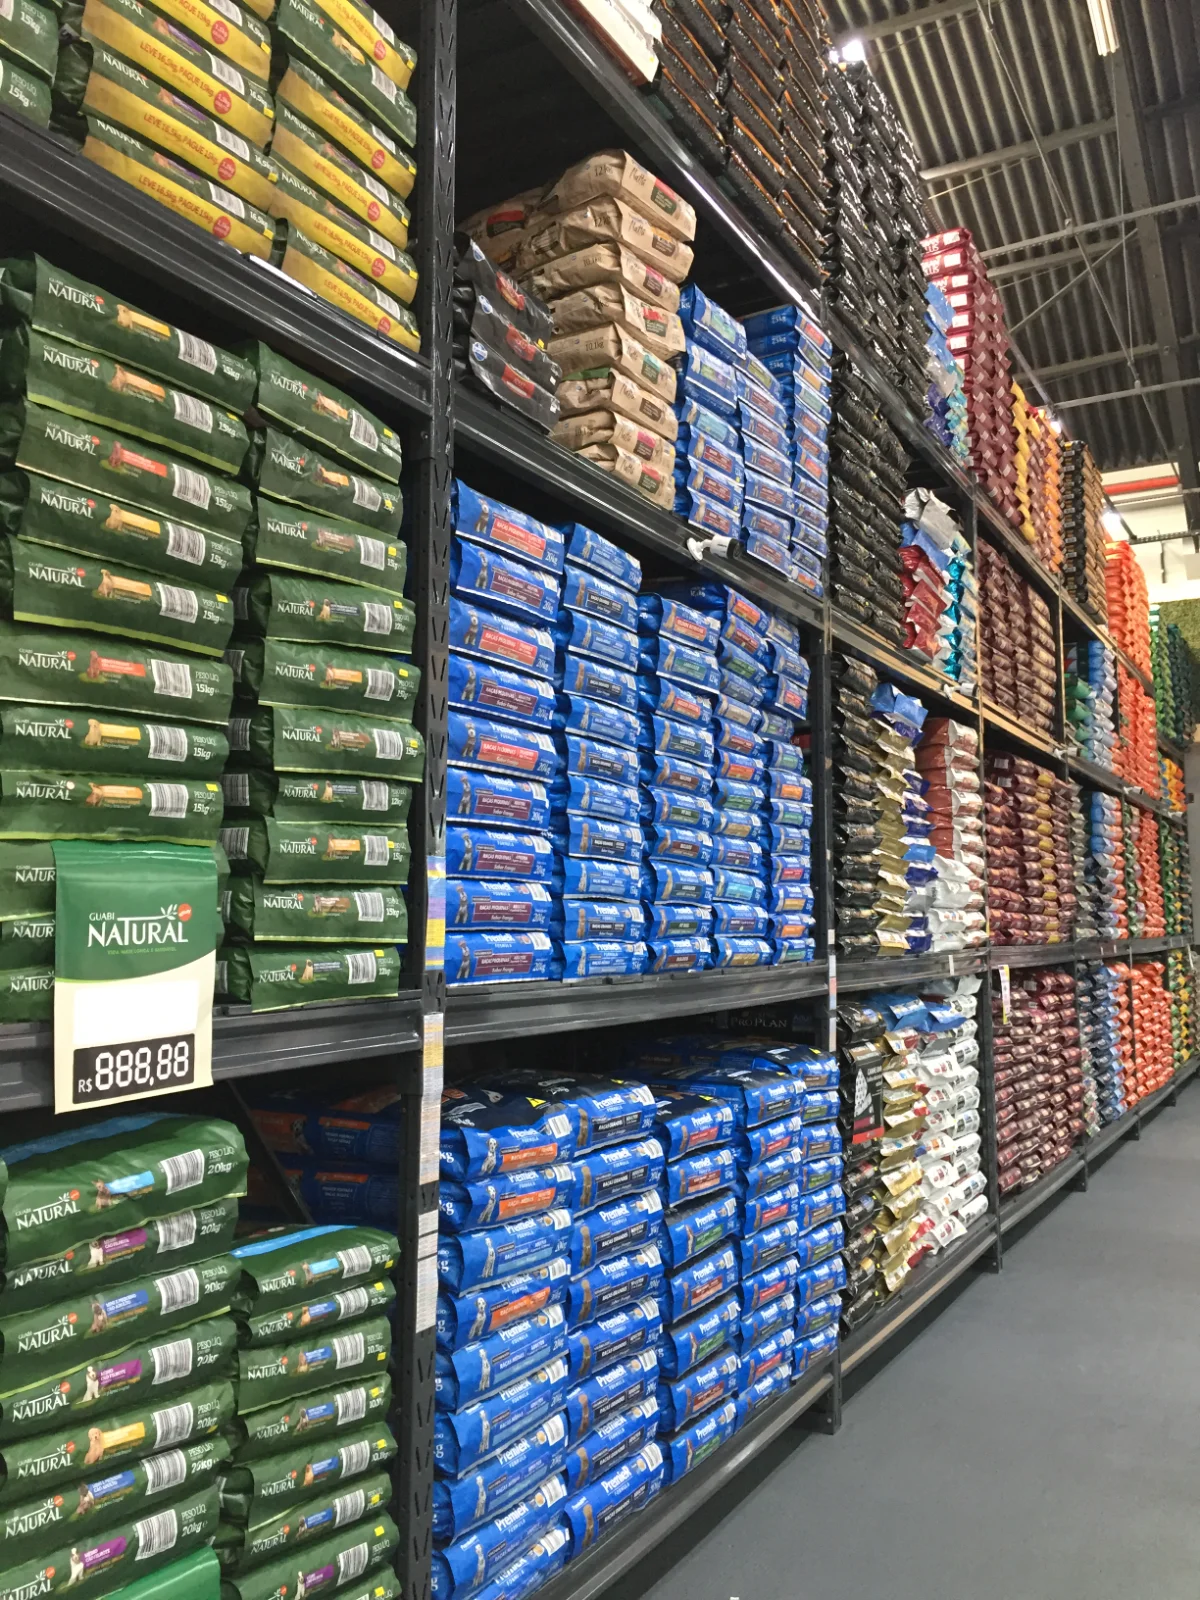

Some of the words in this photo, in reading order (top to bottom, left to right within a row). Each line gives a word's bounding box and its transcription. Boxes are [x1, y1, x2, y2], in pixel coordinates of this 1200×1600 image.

[20, 11, 41, 35] 15kg
[102, 51, 150, 89] NATURAL
[140, 41, 159, 58] LEVE
[179, 63, 202, 87] PAGUE
[9, 84, 30, 107] 15kg
[96, 119, 145, 151] NATURAL
[138, 174, 157, 191] LEVE
[178, 196, 202, 217] PAGUE
[48, 281, 105, 315] NATURAL
[43, 349, 99, 379] NATURAL
[270, 374, 306, 400] NATURAL
[44, 427, 97, 456] NATURAL
[40, 491, 94, 519] NATURAL
[215, 497, 233, 513] 15kg
[267, 521, 307, 540] NATURAL
[209, 553, 228, 569] 15kg
[28, 567, 85, 588] NATURAL
[202, 610, 220, 624] 15kg
[277, 602, 315, 617] NATURAL
[18, 652, 75, 673] NATURAL
[275, 664, 315, 681] NATURAL
[195, 683, 215, 697] 15kg
[15, 722, 72, 740] NATURAL
[282, 729, 322, 743] NATURAL
[193, 746, 211, 760] 15kg
[16, 783, 72, 801] NATURAL
[283, 786, 318, 799] NATURAL
[279, 841, 316, 855] NATURAL
[15, 867, 56, 883] NATUR
[263, 896, 304, 910] NATURAL
[89, 912, 115, 921] GUABI
[12, 923, 55, 939] NATUR
[87, 917, 189, 948] NATURAL
[10, 976, 55, 993] NATURA
[259, 970, 296, 984] NATURAL
[754, 1017, 788, 1029] PLAN
[78, 1078, 93, 1094] R$
[94, 1040, 189, 1091] 888,88
[208, 1149, 223, 1160] PESO
[207, 1162, 232, 1175] 20kg
[16, 1201, 81, 1230] NATURAL
[200, 1223, 221, 1235] 20kg
[14, 1260, 73, 1288] NATURAL
[261, 1277, 296, 1294] NATURAL
[258, 1321, 293, 1337] NATURAL
[18, 1324, 77, 1353] NATURAL
[247, 1366, 288, 1380] NATURAL
[12, 1393, 70, 1422] NATURAL
[256, 1424, 290, 1440] NATURAL
[17, 1453, 73, 1479] NATURAL
[261, 1480, 296, 1498] NATURAL
[5, 1506, 63, 1539] NATURAL
[181, 1509, 195, 1522] PESO
